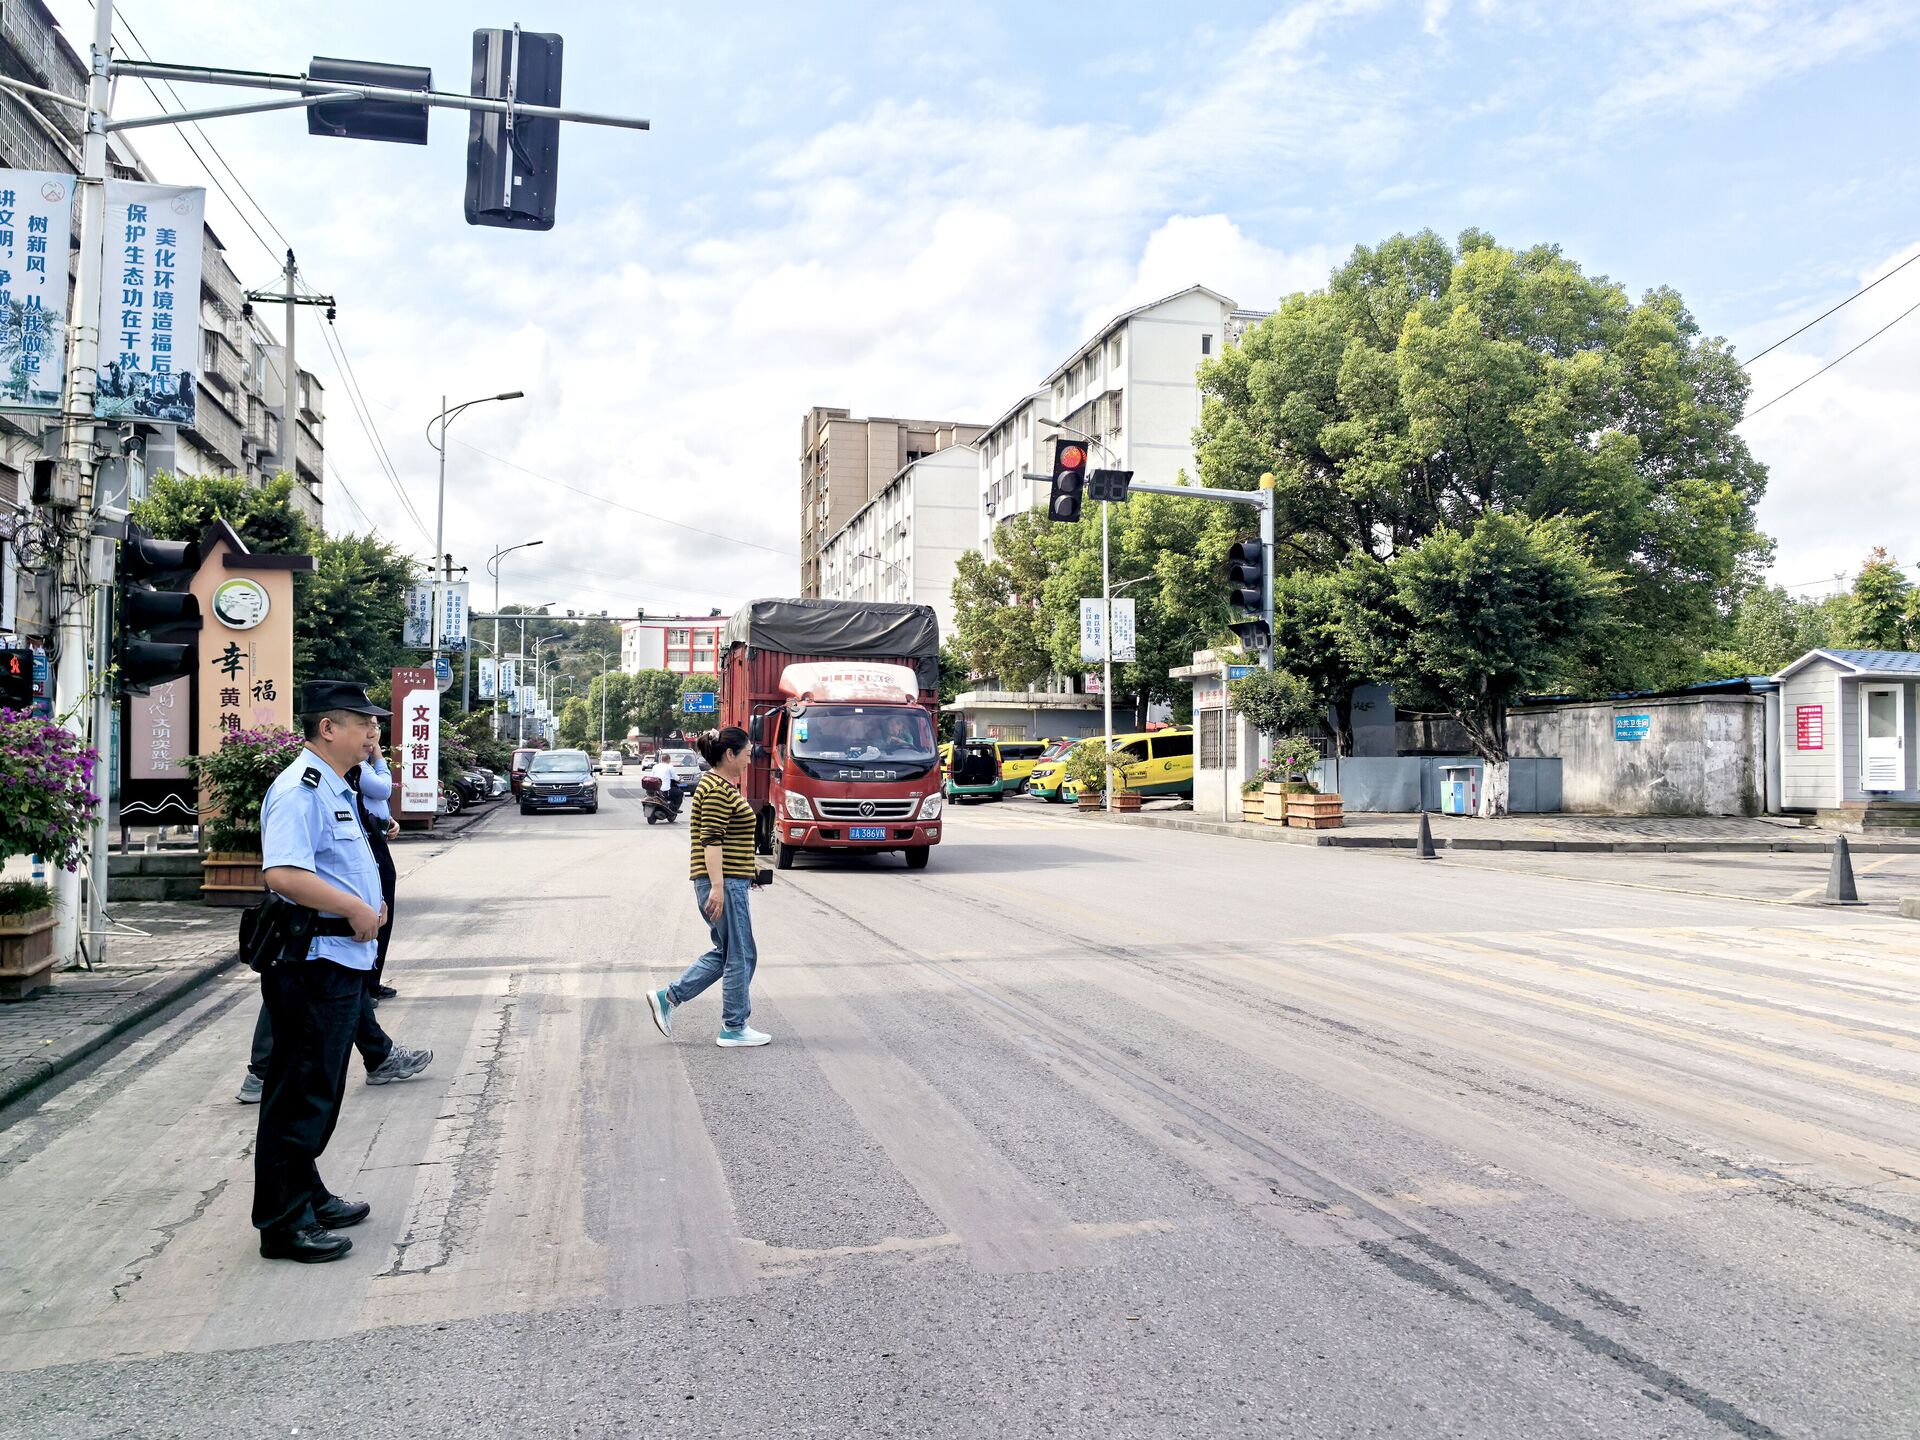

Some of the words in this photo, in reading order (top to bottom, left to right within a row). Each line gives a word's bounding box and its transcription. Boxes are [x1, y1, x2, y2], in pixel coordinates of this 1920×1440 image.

[20, 215, 48, 374] 树新风，从我做起
[119, 203, 147, 371] 保护生态功在千秋
[149, 227, 177, 395] 美化环境造福后代
[412, 705, 430, 779] 文明街区
[838, 770, 897, 779] FOTON
